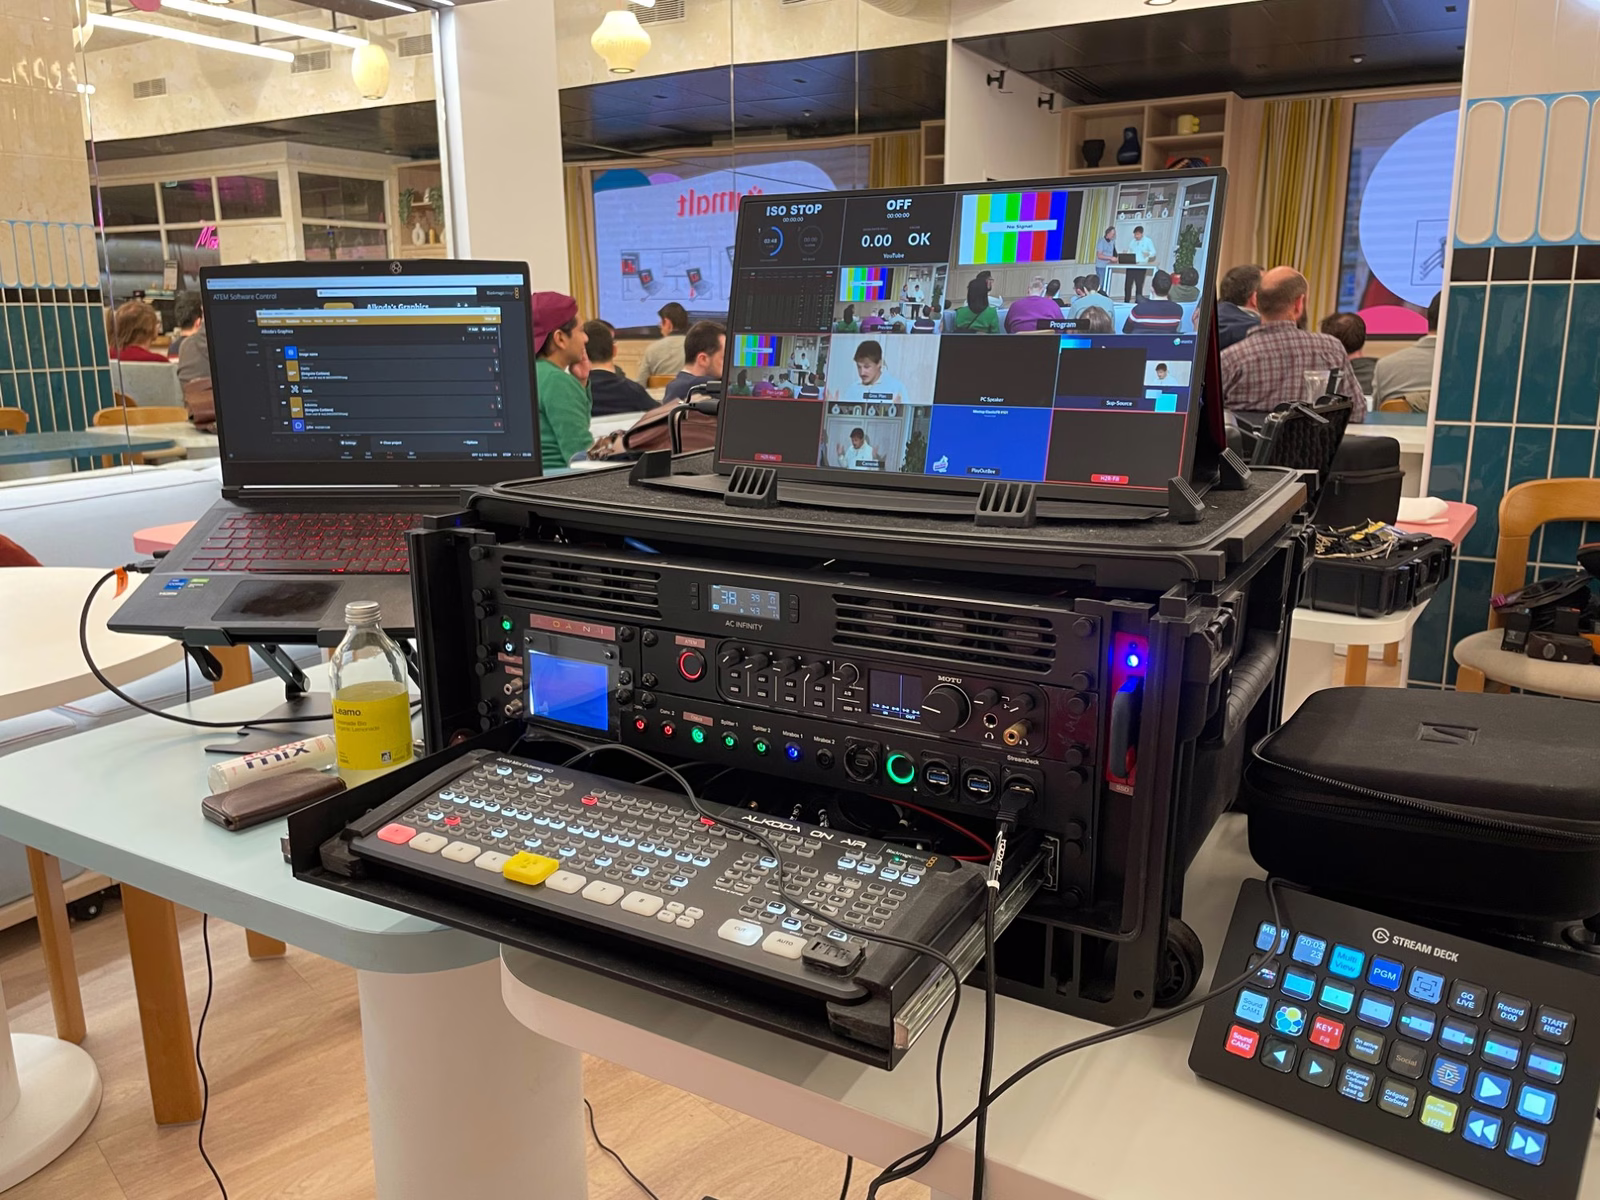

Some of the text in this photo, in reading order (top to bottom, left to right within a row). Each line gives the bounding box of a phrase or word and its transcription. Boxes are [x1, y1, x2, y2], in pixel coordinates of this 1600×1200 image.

[766, 203, 822, 217] ISO STOP
[886, 199, 912, 211] OFF
[861, 232, 931, 248] 0.00 OK
[1050, 321, 1077, 329] Program
[721, 590, 737, 605] 38
[735, 622, 763, 631] INFINITY
[937, 675, 962, 684] MOTU
[782, 730, 800, 738] Mirabox
[813, 736, 831, 744] Mirabox
[1007, 755, 1040, 766] StreamDeck
[742, 814, 867, 849] ALKODA ON AIR
[734, 925, 747, 933] CUT
[1262, 926, 1287, 939] MEU
[777, 938, 793, 946] AUTO
[1392, 935, 1460, 963] STREAM DECK
[1337, 951, 1357, 963] Multi
[1335, 961, 1356, 973] View
[1373, 967, 1396, 981] PGM
[1460, 991, 1475, 1001] GO
[1243, 997, 1263, 1008] Sound
[1456, 999, 1475, 1009] LIVE
[1241, 1004, 1260, 1016] CAM1
[1497, 1002, 1525, 1016] Record
[1500, 1011, 1518, 1022] 0:00
[1541, 1015, 1568, 1029] START
[1315, 1021, 1333, 1033] KEY
[1543, 1024, 1562, 1036] REC
[1232, 1032, 1253, 1044] Sound
[1231, 1039, 1251, 1051] CAM2
[1396, 1054, 1417, 1067] Social
[1348, 1081, 1363, 1091] Team
